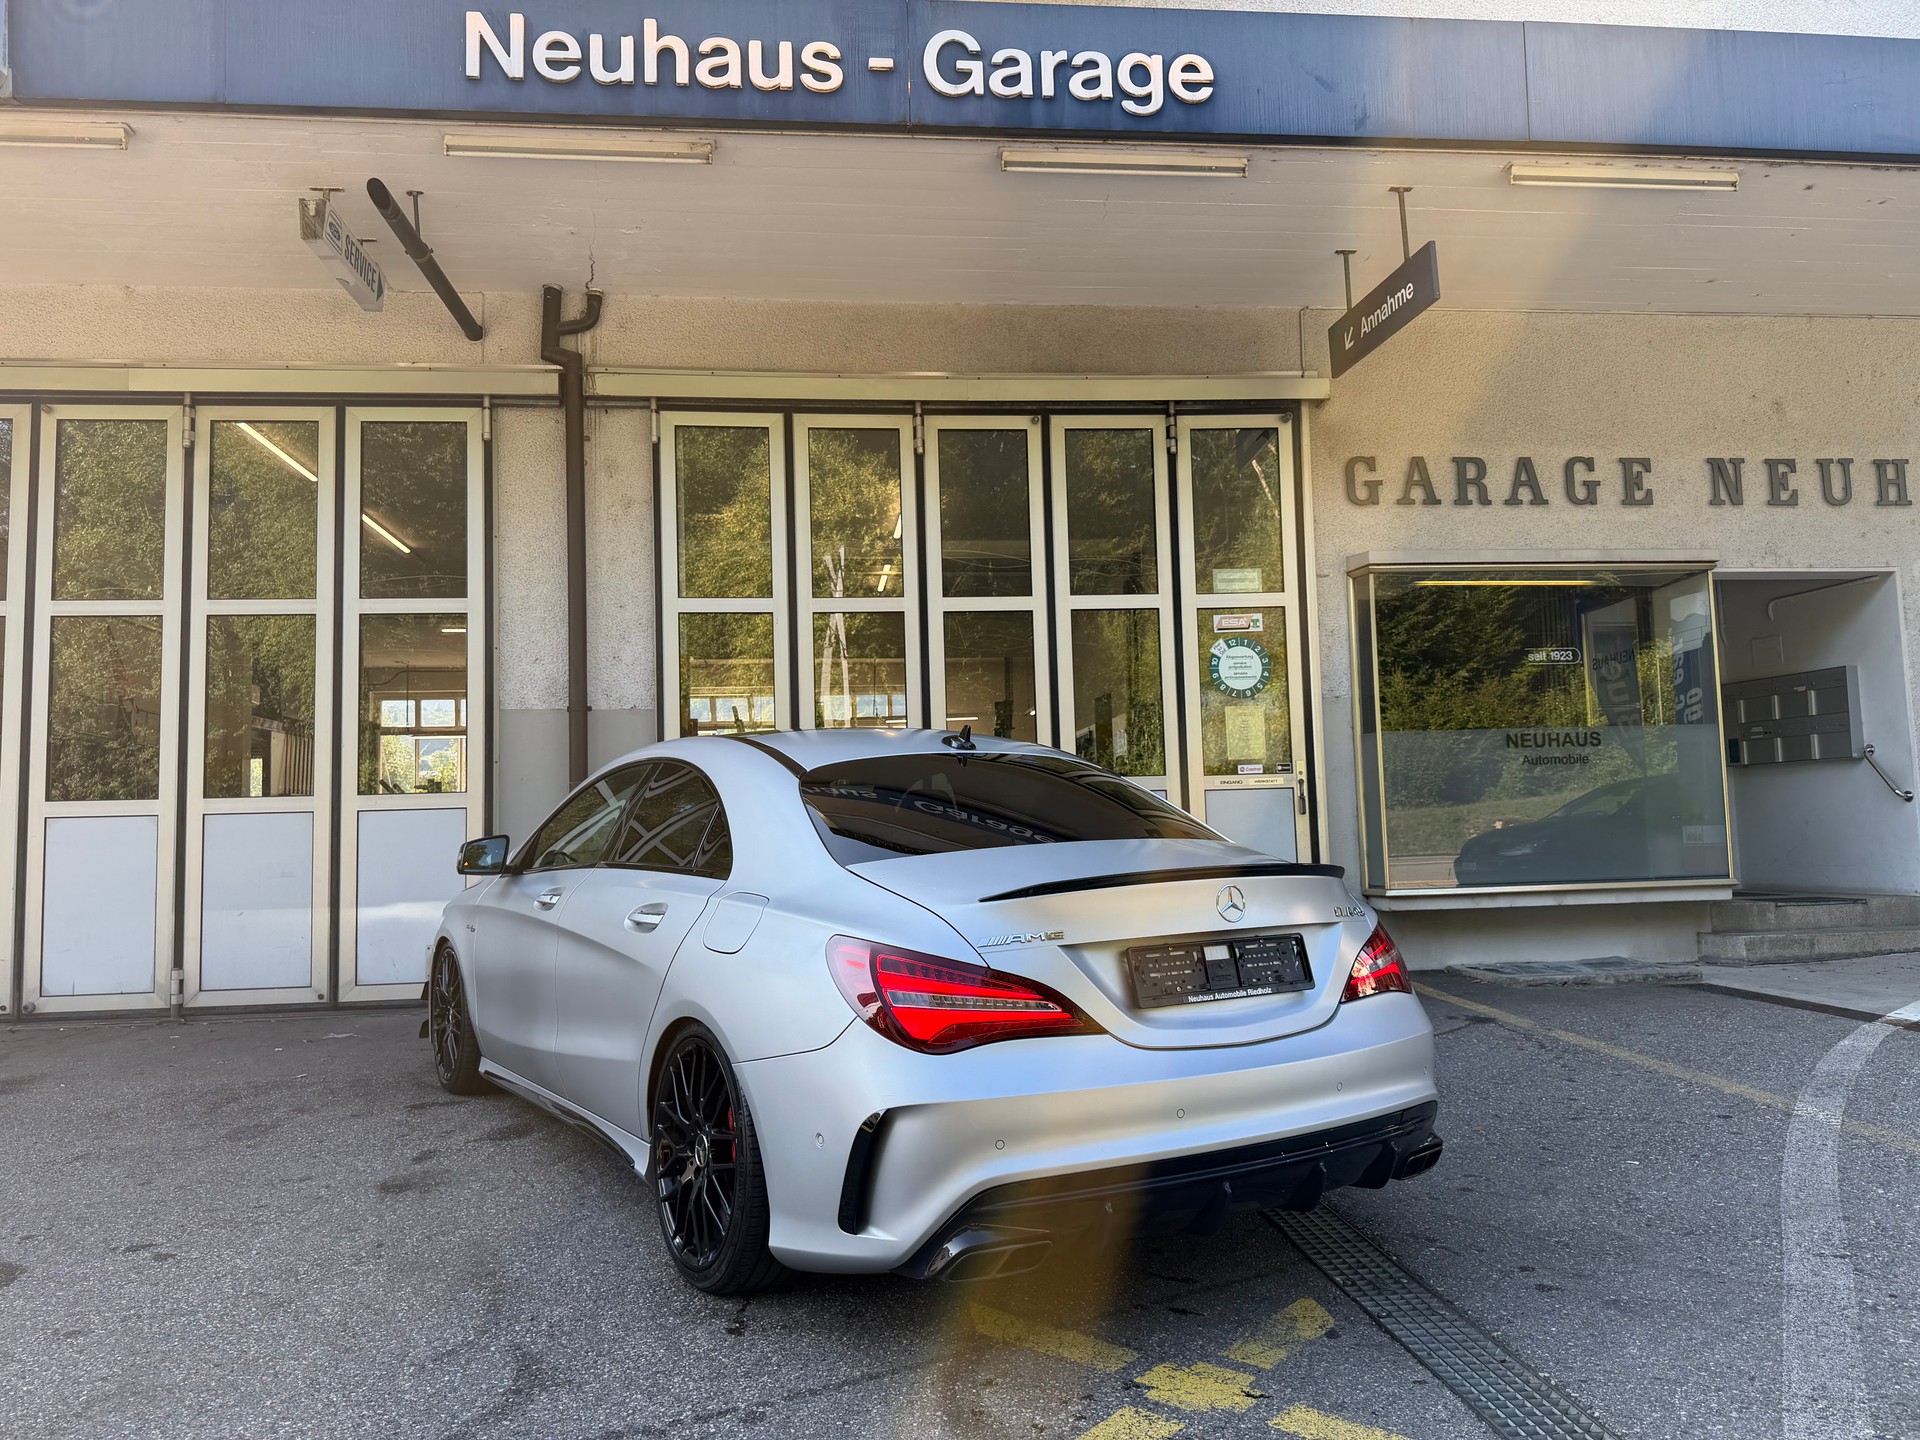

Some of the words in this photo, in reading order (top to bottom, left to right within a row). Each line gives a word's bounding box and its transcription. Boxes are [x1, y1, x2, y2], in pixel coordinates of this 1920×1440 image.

[465, 11, 844, 93] Neuhaus
[923, 29, 1215, 117] Garage
[344, 234, 376, 293] SERVICE
[1360, 282, 1414, 338] Annahme
[1345, 456, 1654, 505] GARAGE
[1706, 458, 1913, 506] NEUH
[1528, 651, 1546, 662] seit
[1550, 651, 1573, 661] 1923
[1506, 732, 1602, 748] NEUHAUS
[1522, 753, 1590, 766] Automobile
[1188, 994, 1214, 1003] Neuhaus
[1215, 989, 1247, 1000] Automobile
[1248, 987, 1272, 997] Riedholz
